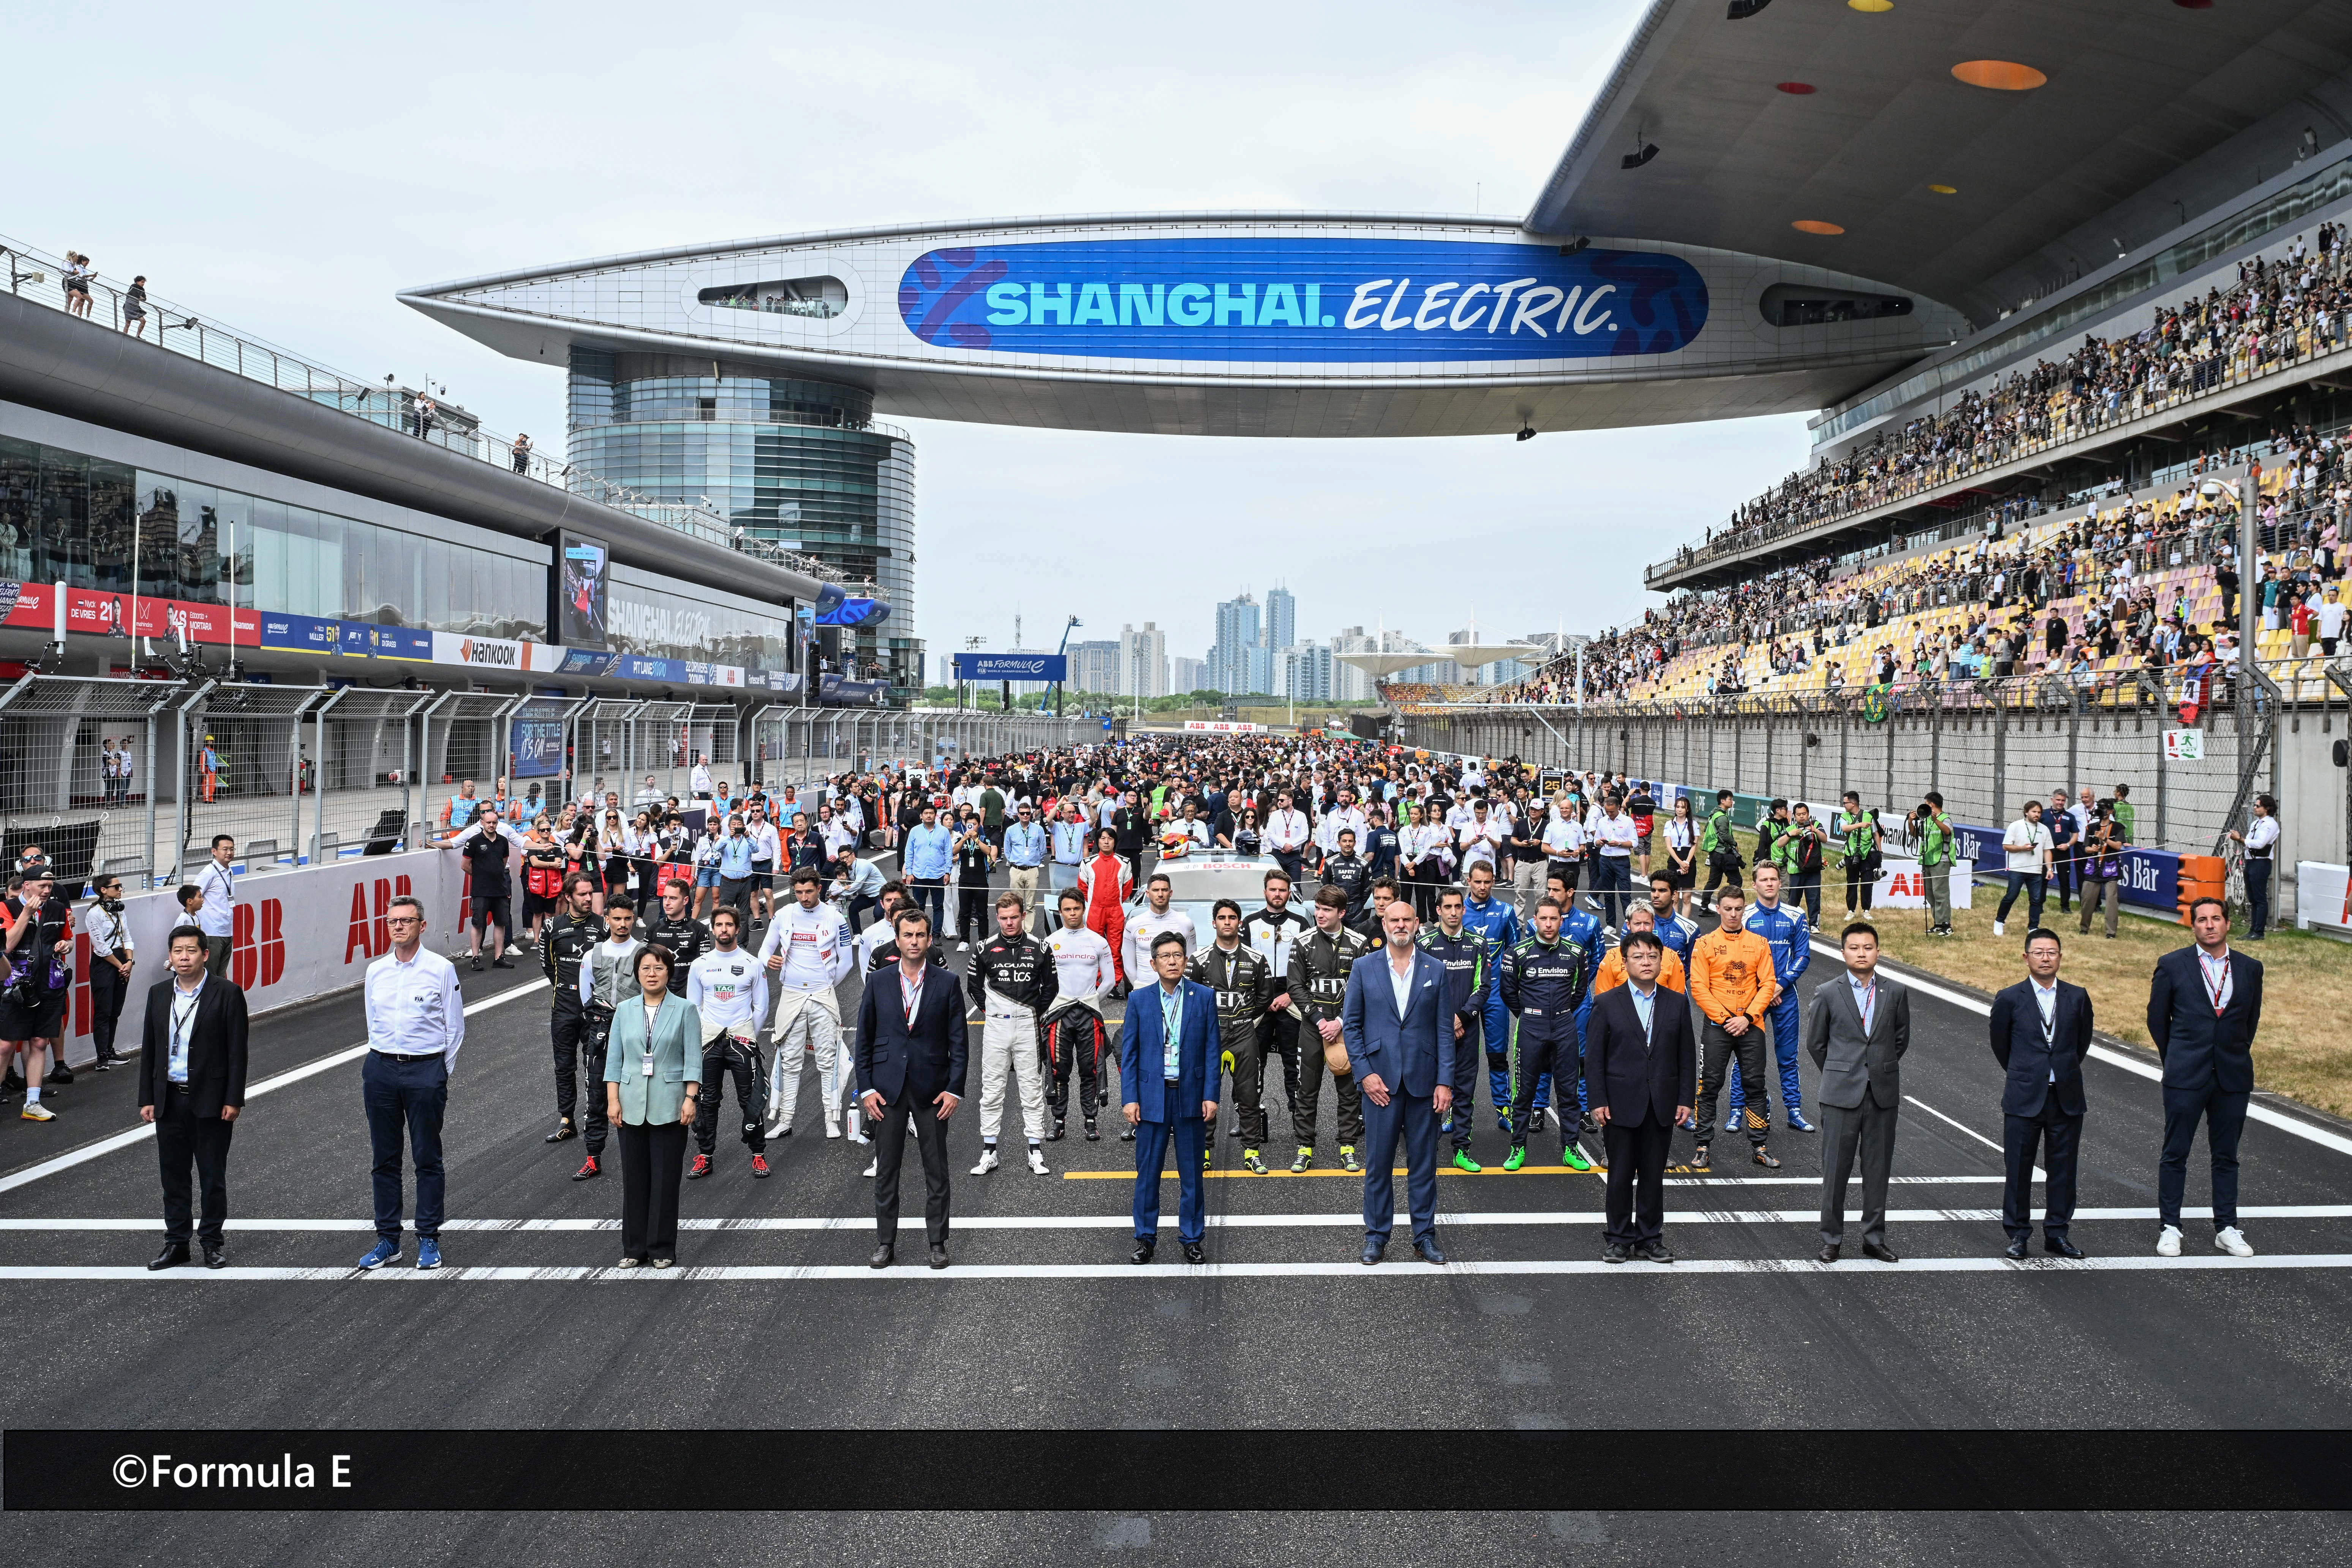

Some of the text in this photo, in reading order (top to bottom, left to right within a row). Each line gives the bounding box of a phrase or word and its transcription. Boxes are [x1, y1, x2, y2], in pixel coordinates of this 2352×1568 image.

[985, 278, 1618, 340] SHANGHAI. ELECTRIC.
[71, 609, 95, 620] DE VRIES
[100, 602, 112, 621] 21
[608, 597, 672, 642] SHANGHAI.
[190, 621, 212, 631] MORTARA
[309, 632, 324, 641] MÜLLER
[327, 626, 334, 642] 51
[348, 632, 357, 640] ABT
[374, 632, 379, 646] 11
[640, 662, 652, 675] LANE
[651, 661, 666, 678] STUDIO
[686, 661, 692, 672] 22
[994, 660, 1031, 669] FORMULA
[688, 674, 705, 685] 200MPH
[749, 674, 759, 684] Fortescue
[771, 681, 783, 691] 200MPH
[522, 723, 561, 738] FOR THE TITLE
[521, 738, 545, 759] IT'S ON
[1544, 781, 1560, 790] 25
[1963, 832, 1981, 859] Bär
[2132, 857, 2159, 891] Bär
[1013, 970, 1031, 982] tcs
